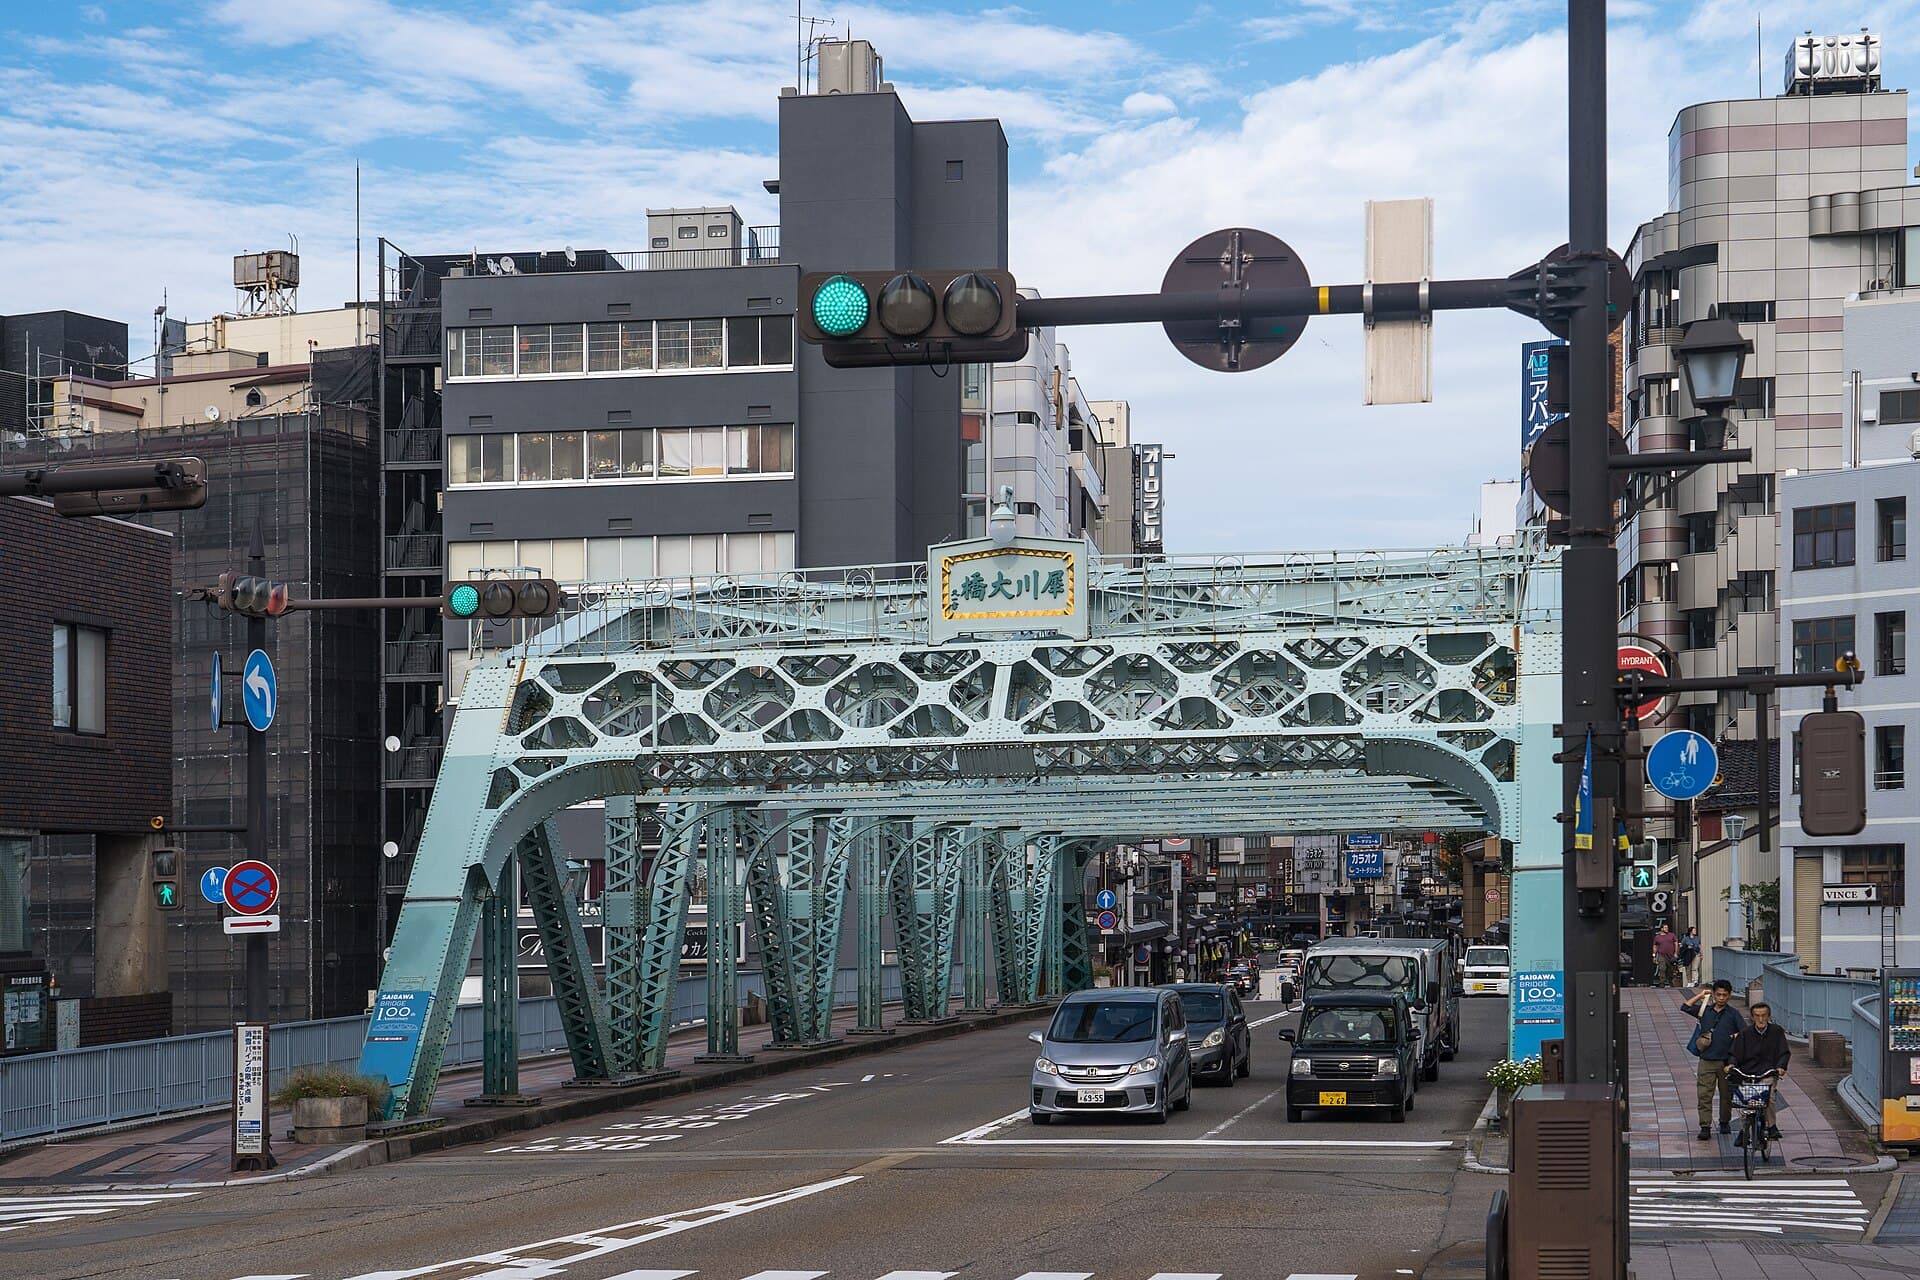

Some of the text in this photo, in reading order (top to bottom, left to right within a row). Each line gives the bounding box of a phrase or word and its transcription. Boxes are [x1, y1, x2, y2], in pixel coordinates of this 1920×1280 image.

[1143, 447, 1161, 542] オーロラビル
[1621, 656, 1655, 665] HYDRANT
[1351, 853, 1378, 865] カラオケ
[1825, 891, 1858, 899] VINCE
[1083, 1094, 1103, 1102] 69-55
